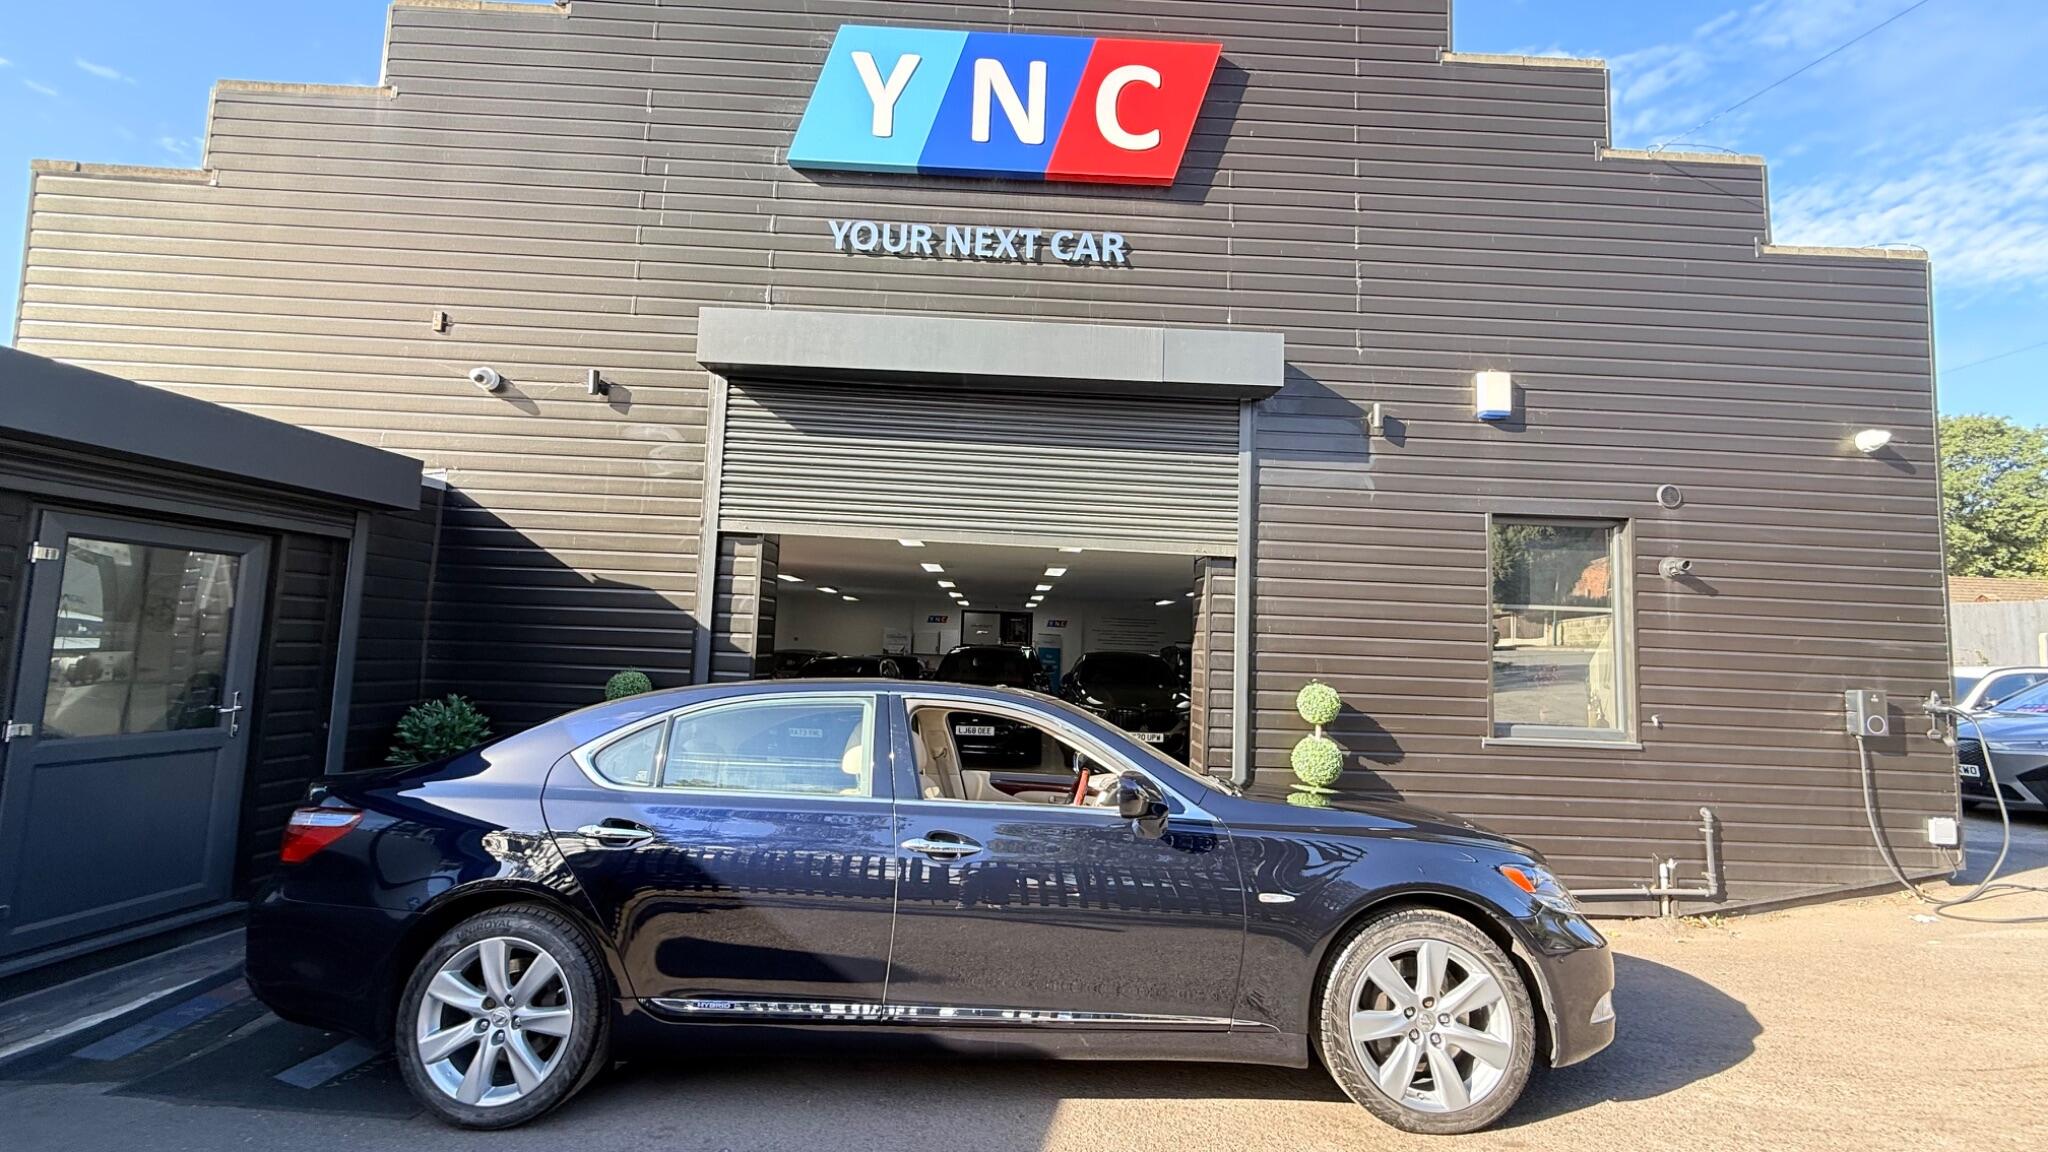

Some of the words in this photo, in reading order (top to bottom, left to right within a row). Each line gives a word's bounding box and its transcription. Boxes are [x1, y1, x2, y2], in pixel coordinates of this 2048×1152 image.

[851, 51, 1162, 151] YNC
[828, 219, 932, 254] YOUR
[945, 224, 1042, 259] NEXT
[1050, 229, 1125, 263] CAR
[456, 919, 512, 940] UNIROYAL
[697, 1001, 731, 1009] HYBRID
